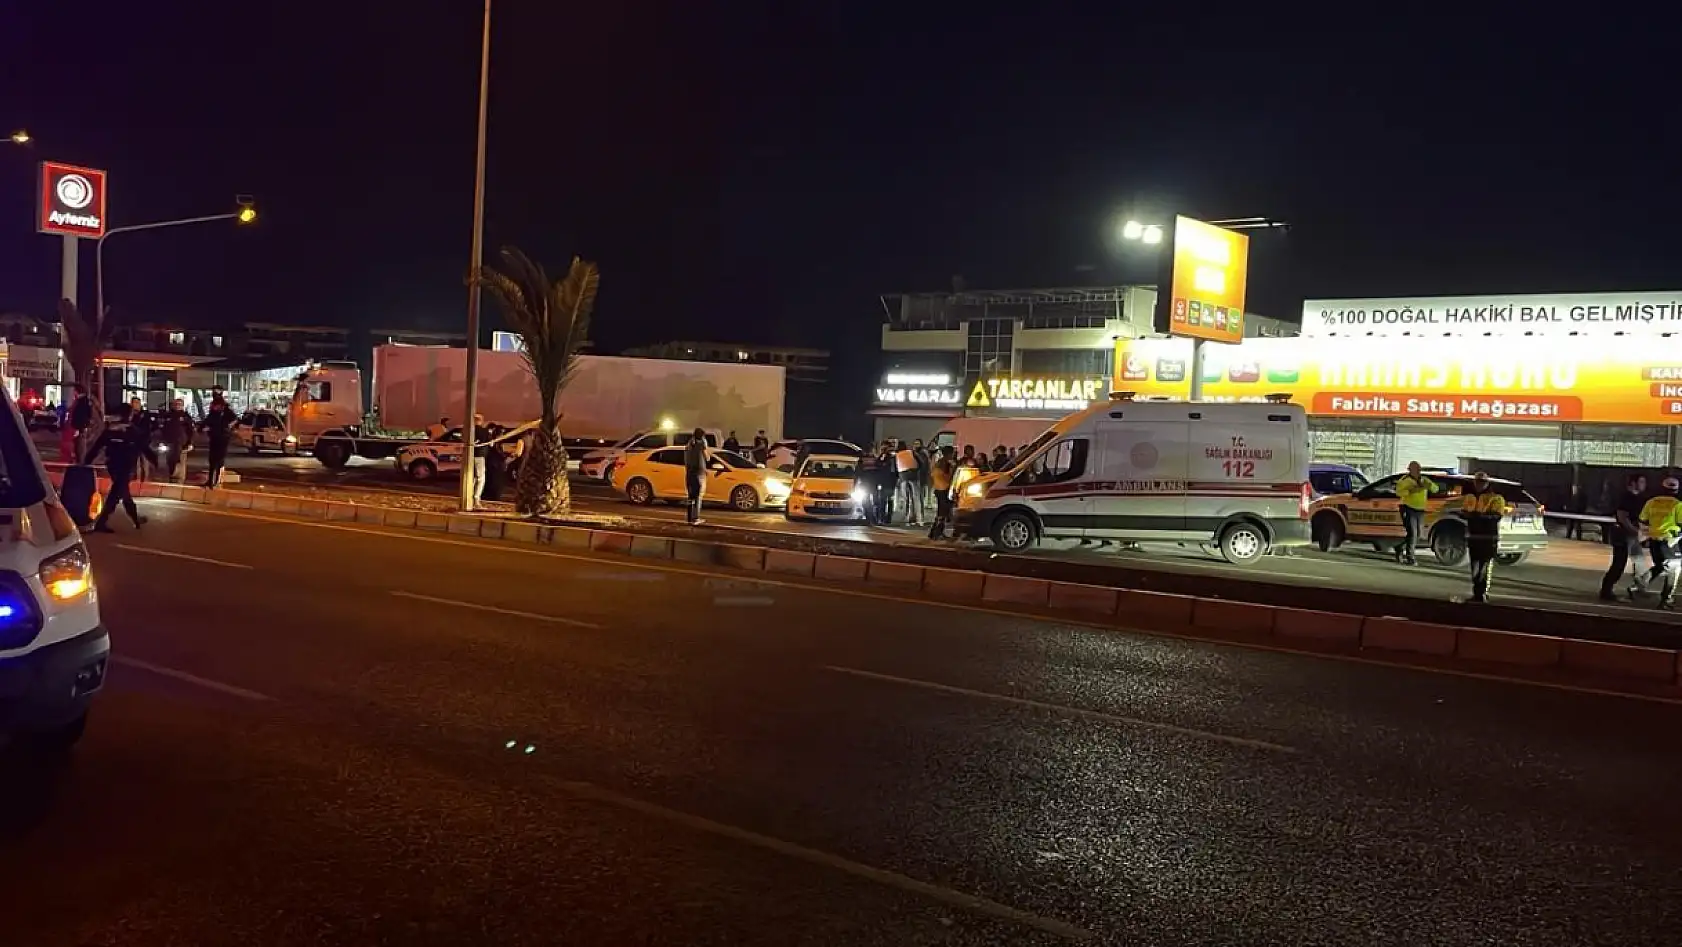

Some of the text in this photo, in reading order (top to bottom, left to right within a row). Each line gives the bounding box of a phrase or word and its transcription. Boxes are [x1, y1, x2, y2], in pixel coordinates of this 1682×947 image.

[49, 210, 101, 228] Aytemiz
[1321, 309, 1367, 325] %100
[1373, 306, 1439, 324] DOĞAL
[1446, 304, 1513, 323] HAKİKİ
[1521, 305, 1562, 322] BAL
[909, 388, 960, 403] GARAJ
[988, 379, 1097, 399] TARCANLAR
[1332, 397, 1559, 417] Fabrika Satış Mağazası
[1223, 460, 1255, 477] 112
